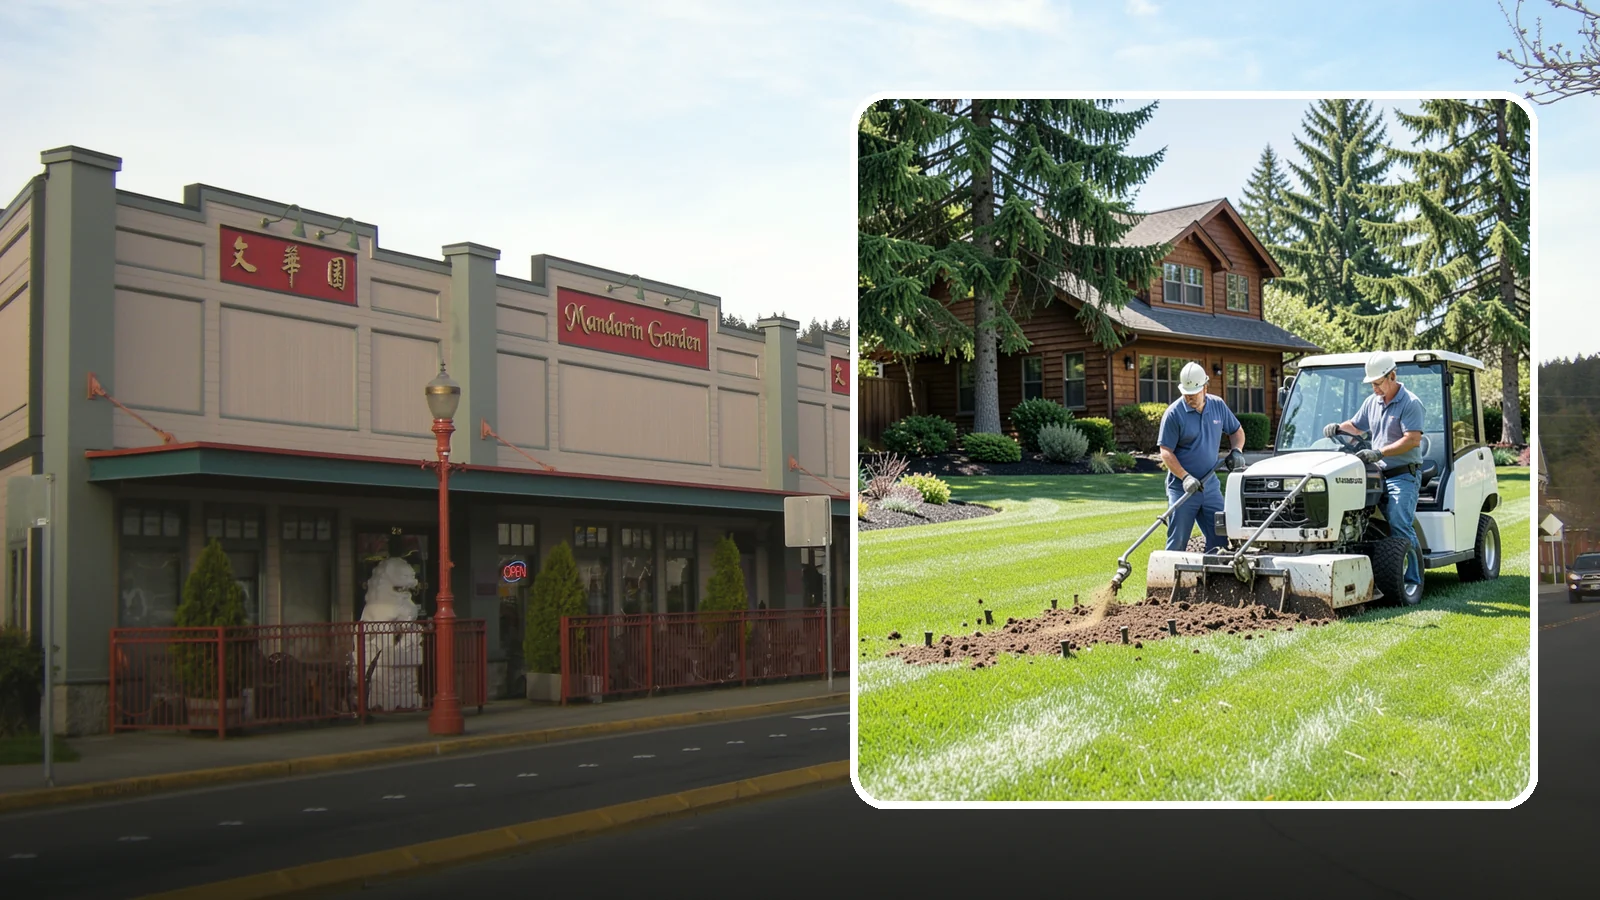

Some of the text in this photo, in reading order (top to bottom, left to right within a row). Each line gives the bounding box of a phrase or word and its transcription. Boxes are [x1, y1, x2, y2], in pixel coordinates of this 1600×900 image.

[230, 235, 346, 291] 文華園
[564, 302, 702, 352] Mandarin Garden
[503, 565, 527, 578] OPEN
